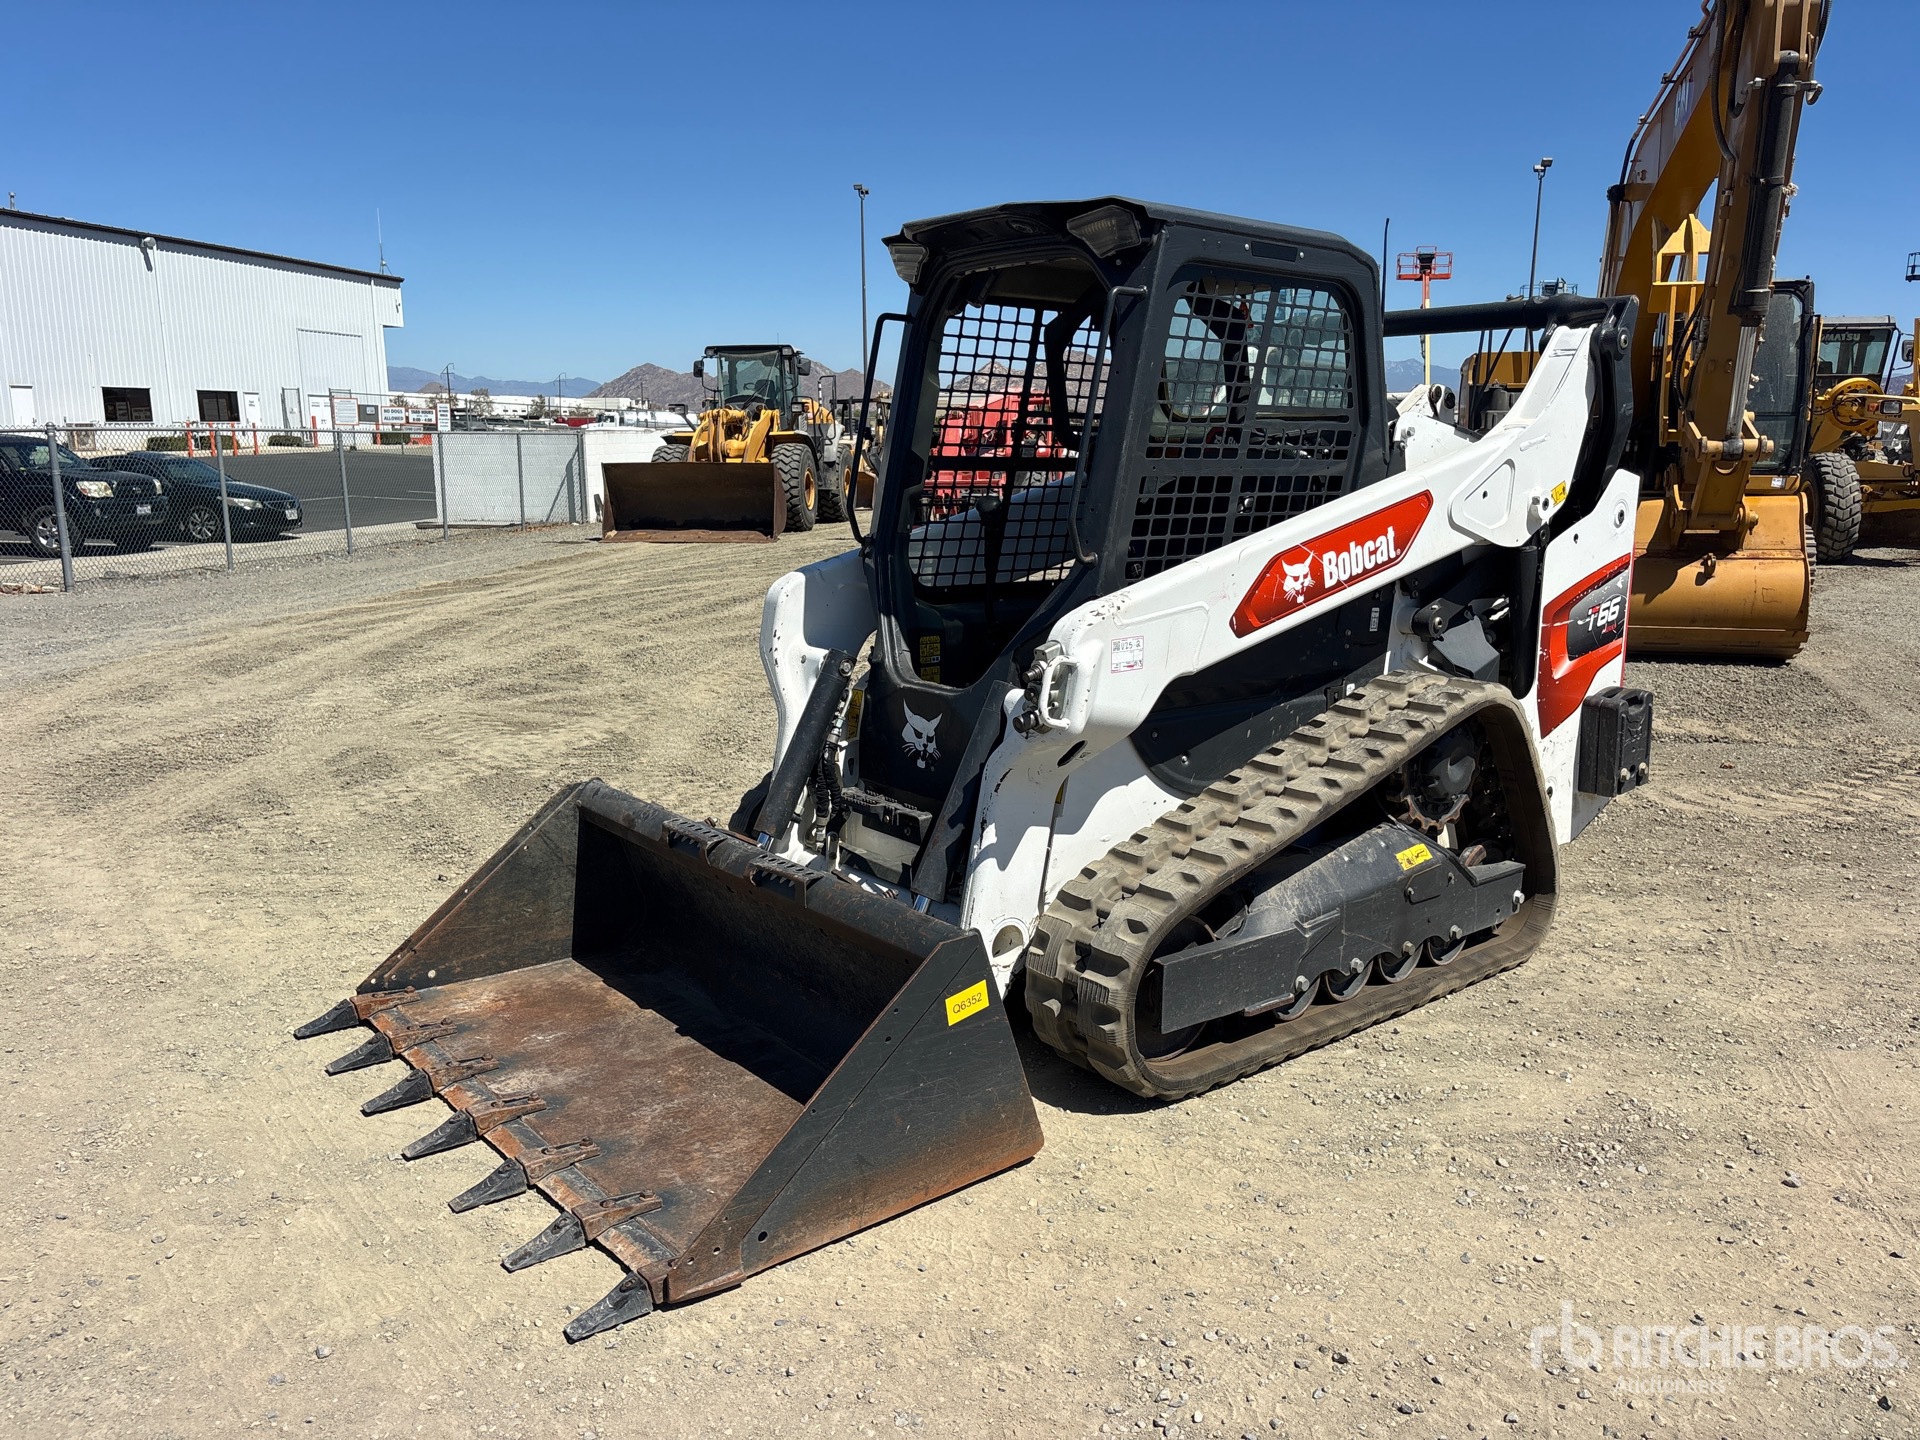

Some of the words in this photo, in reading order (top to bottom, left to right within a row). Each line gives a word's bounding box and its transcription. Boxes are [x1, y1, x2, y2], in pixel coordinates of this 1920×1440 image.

[1822, 333, 1861, 341] MATSU
[1323, 526, 1396, 588] Bobcat
[1587, 596, 1621, 631] T66
[952, 992, 982, 1014] Q6352
